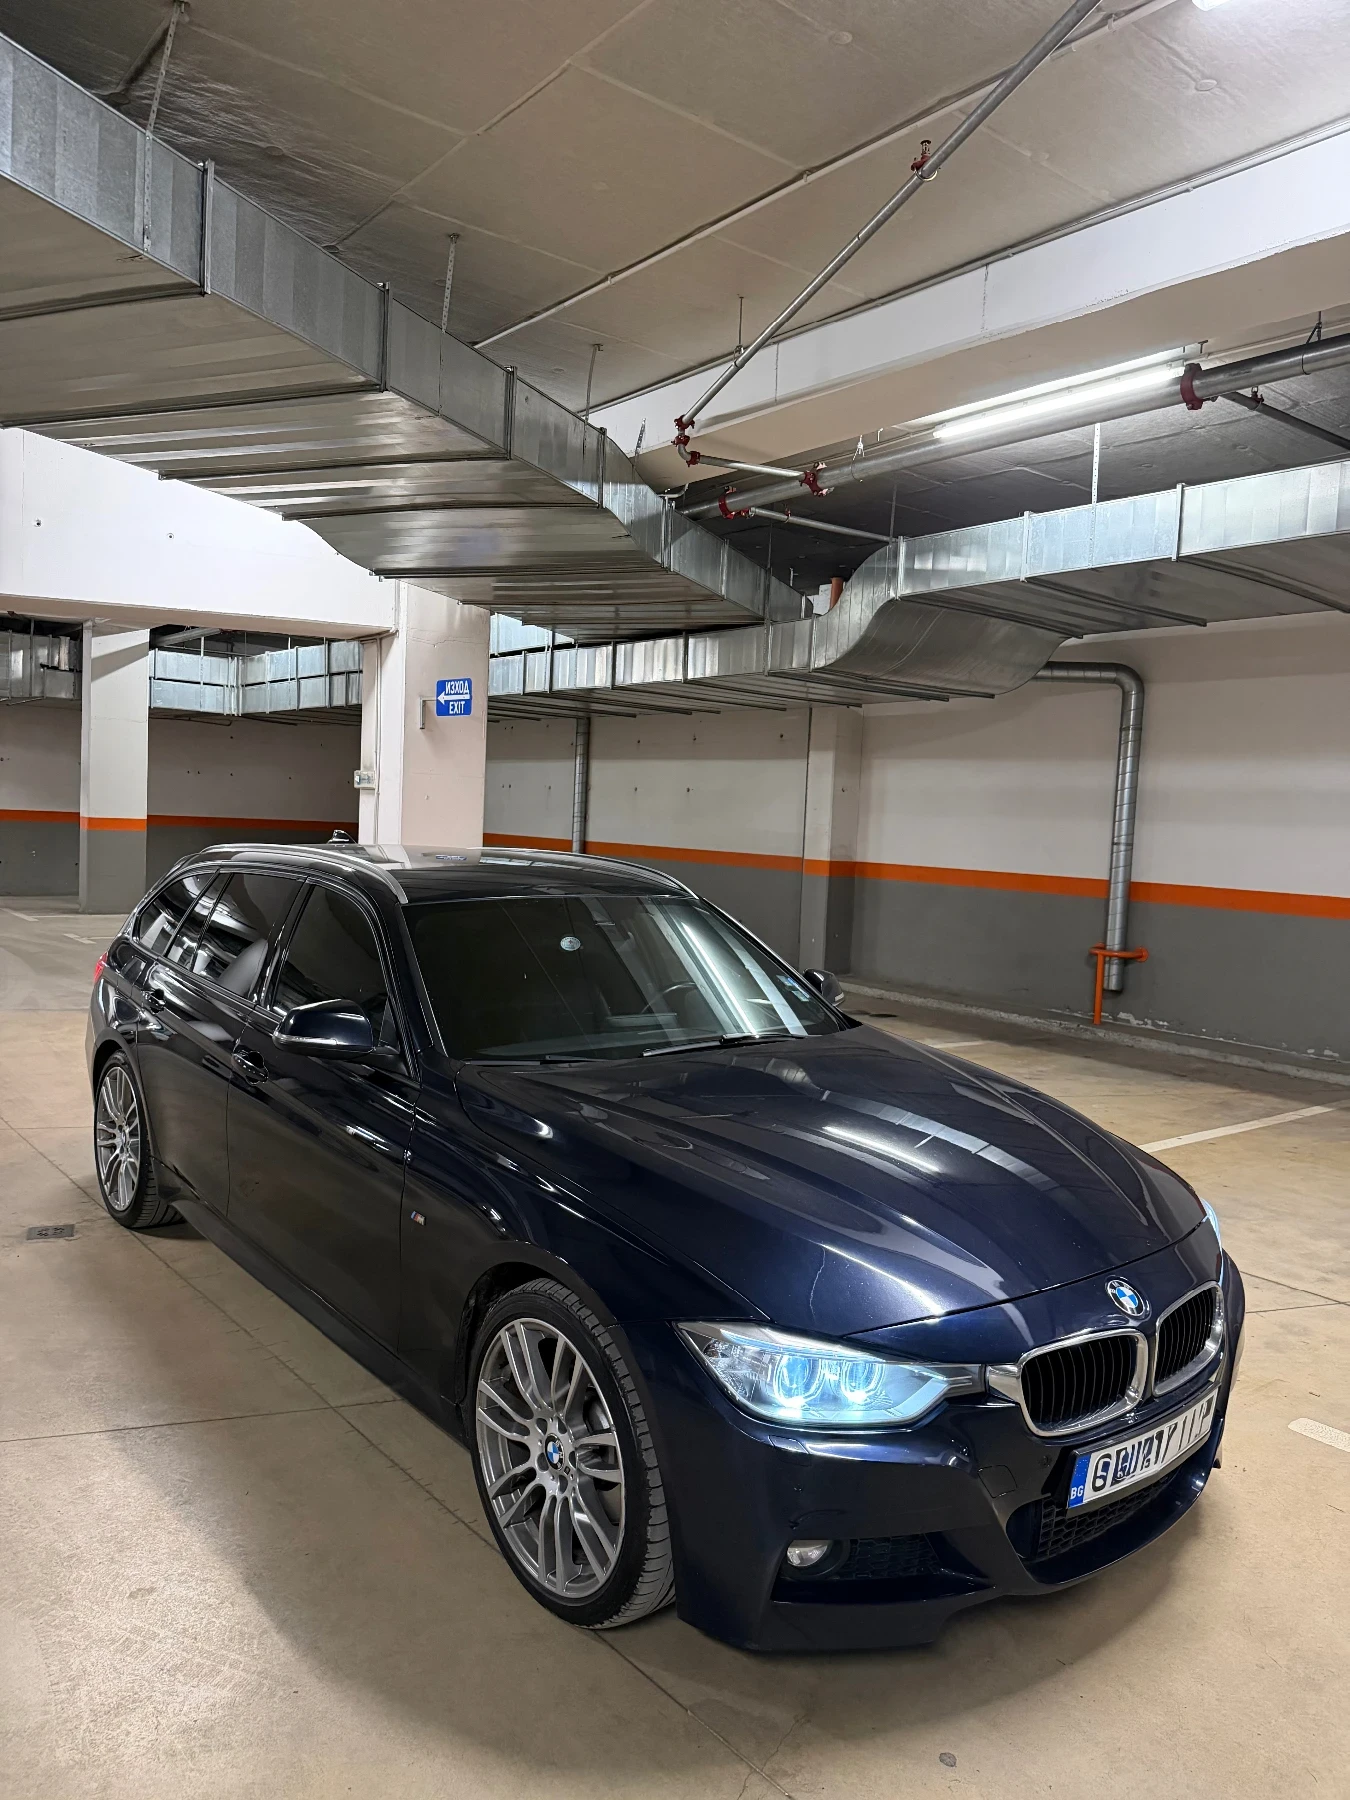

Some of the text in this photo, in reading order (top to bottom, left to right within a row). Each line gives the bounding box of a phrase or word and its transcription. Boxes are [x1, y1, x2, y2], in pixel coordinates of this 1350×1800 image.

[445, 680, 470, 695] ИЗХОД
[449, 701, 466, 714] EXIT
[1070, 1485, 1084, 1500] BG
